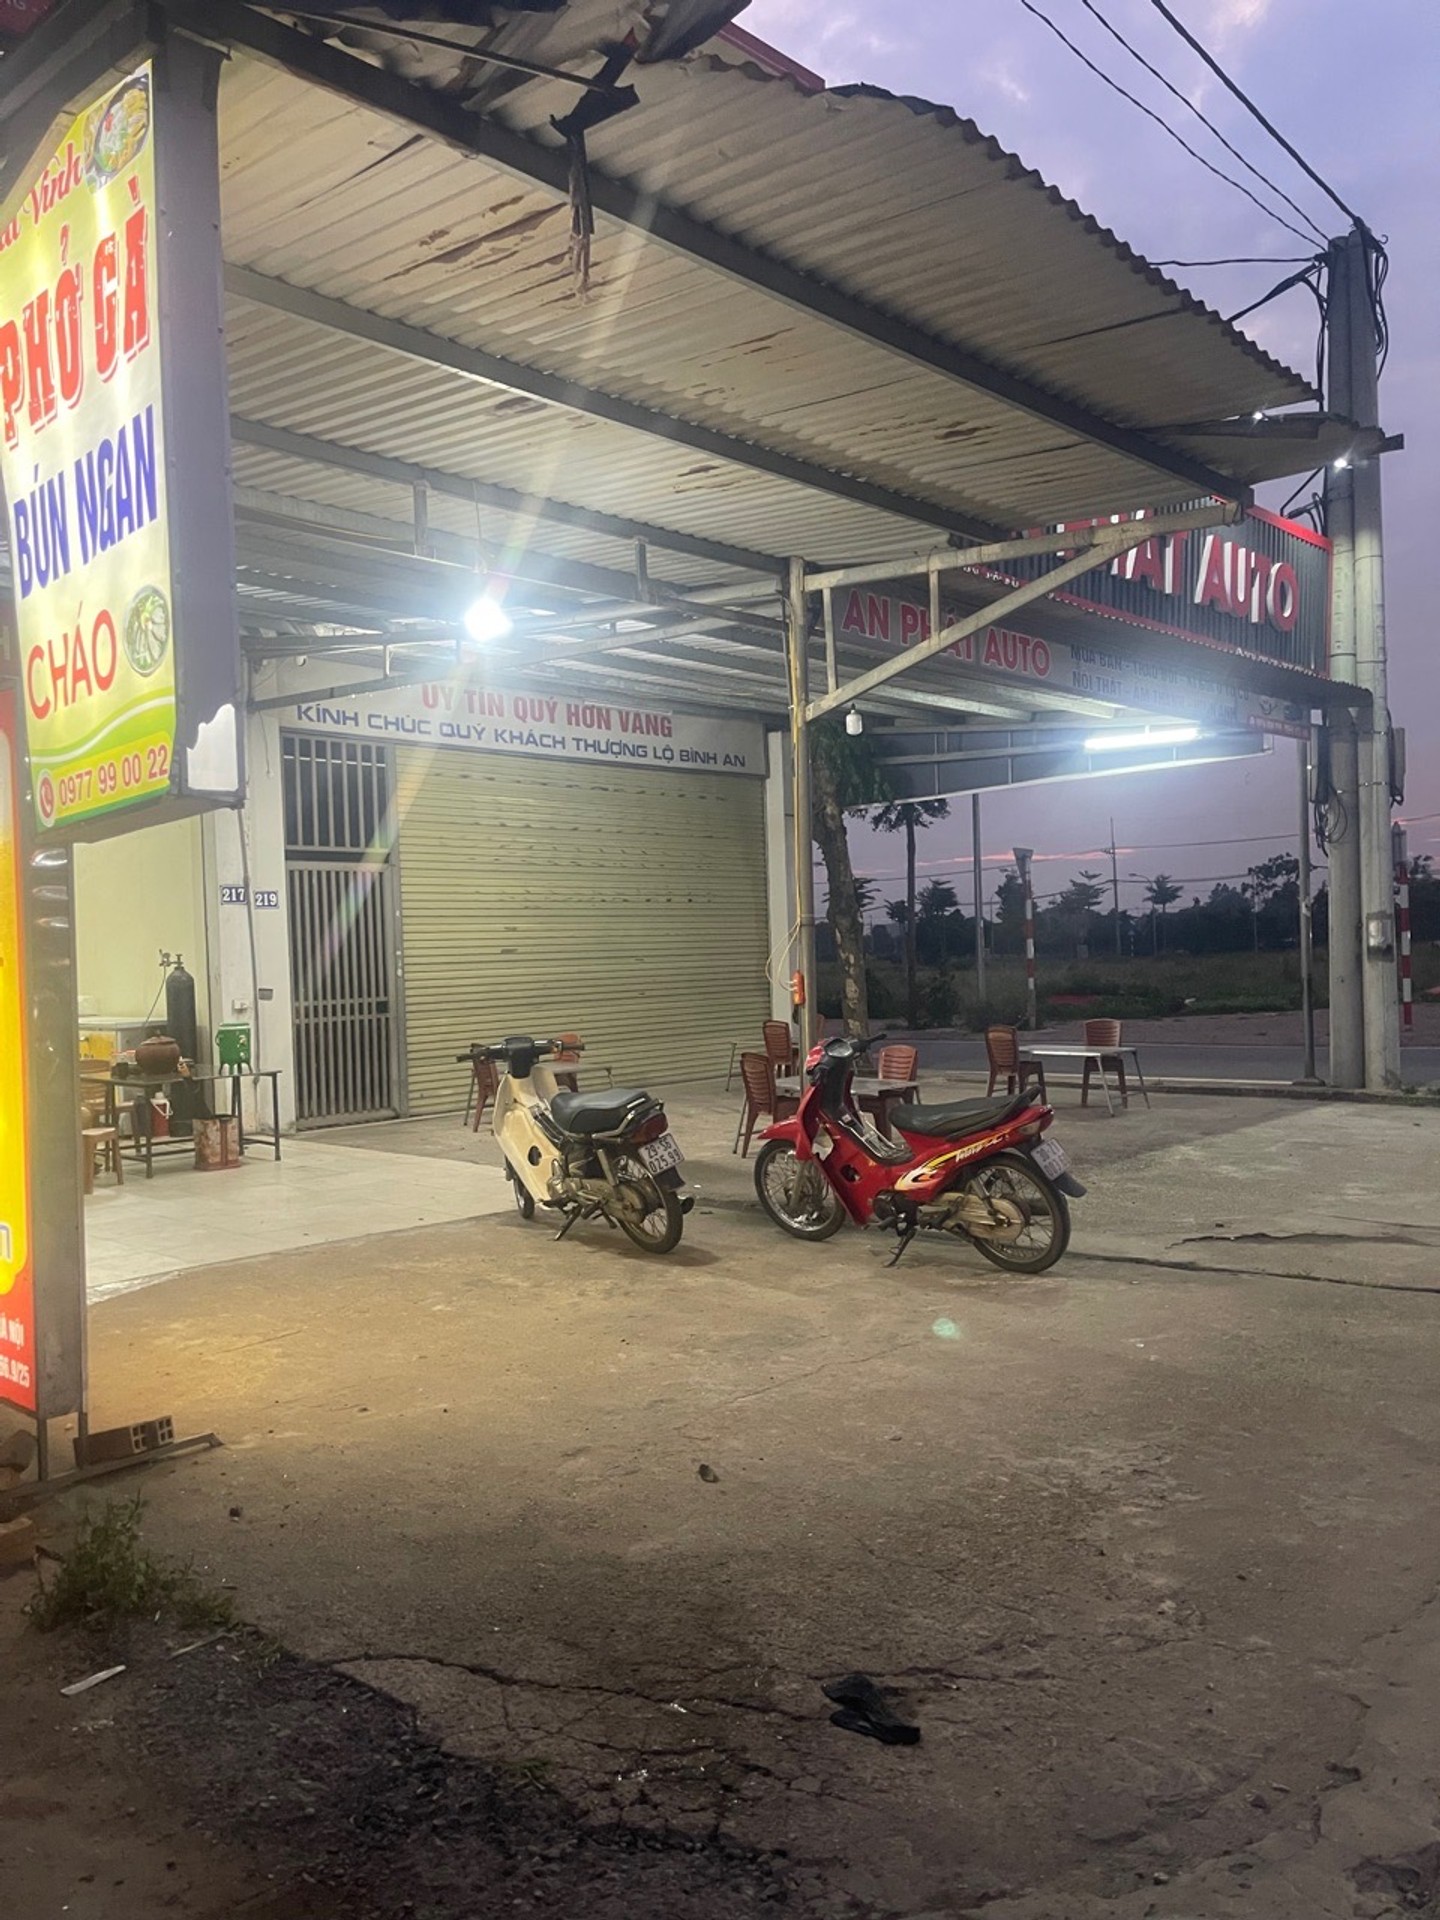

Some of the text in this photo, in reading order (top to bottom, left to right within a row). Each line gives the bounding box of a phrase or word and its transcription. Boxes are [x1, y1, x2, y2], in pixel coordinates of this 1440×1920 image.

[0, 175, 150, 451] PHỞ GÀ
[13, 404, 158, 599] BÚN NGAN
[1194, 534, 1299, 632] AUTO
[28, 601, 117, 719] CHÁO
[842, 588, 891, 642] AN
[983, 625, 1052, 678] AUTO
[297, 703, 746, 768] KÍNH CHÚC QUÝ KHÁCH THƯỢNG LỘ BÌNH AN
[512, 695, 558, 724] QUÝ
[59, 744, 169, 806] 0977 99 00 22
[222, 888, 245, 901] 217
[255, 893, 277, 906] 219
